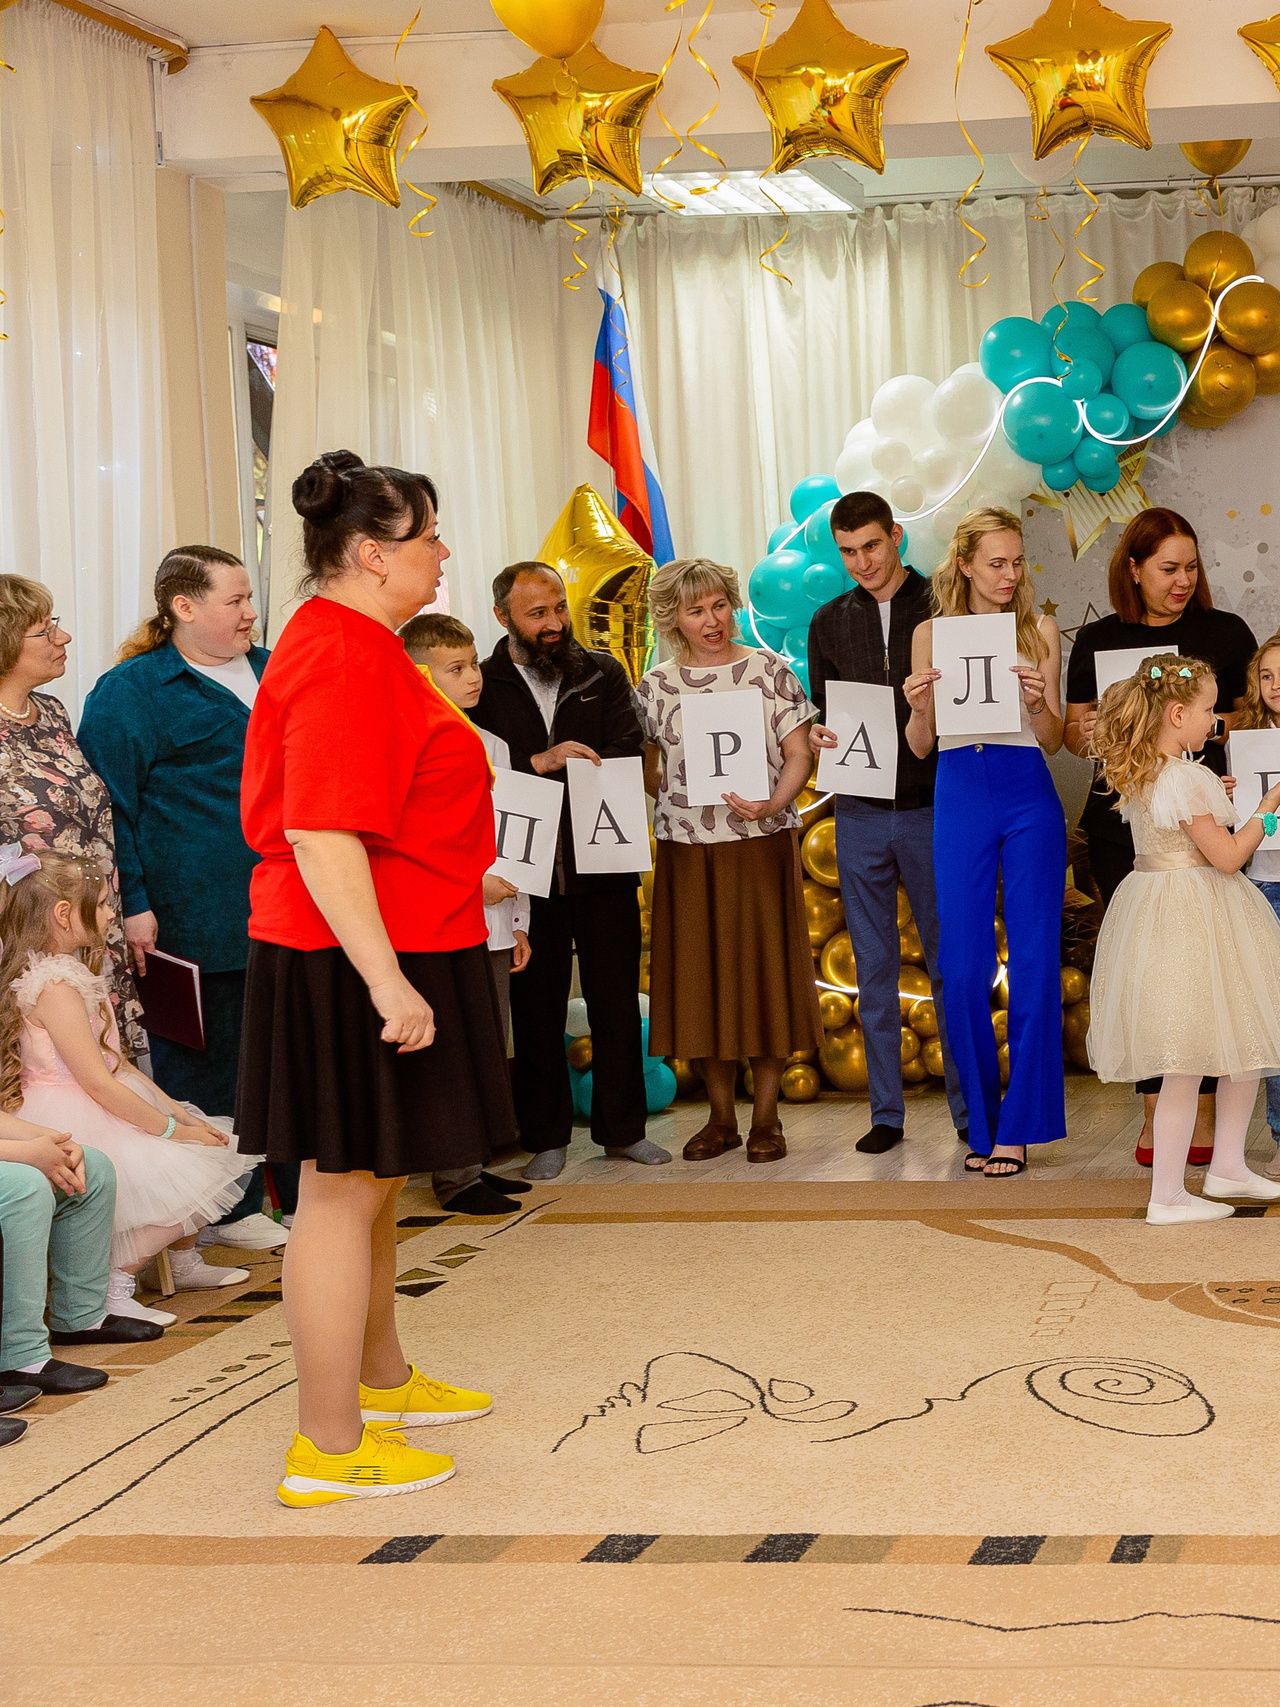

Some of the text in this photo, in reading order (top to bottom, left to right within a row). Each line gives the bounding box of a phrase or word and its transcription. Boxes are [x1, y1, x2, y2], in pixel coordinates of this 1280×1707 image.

[952, 655, 1000, 706] Л
[705, 731, 742, 778] Р
[835, 721, 882, 770] А
[495, 808, 543, 866] П
[587, 798, 633, 846] А
